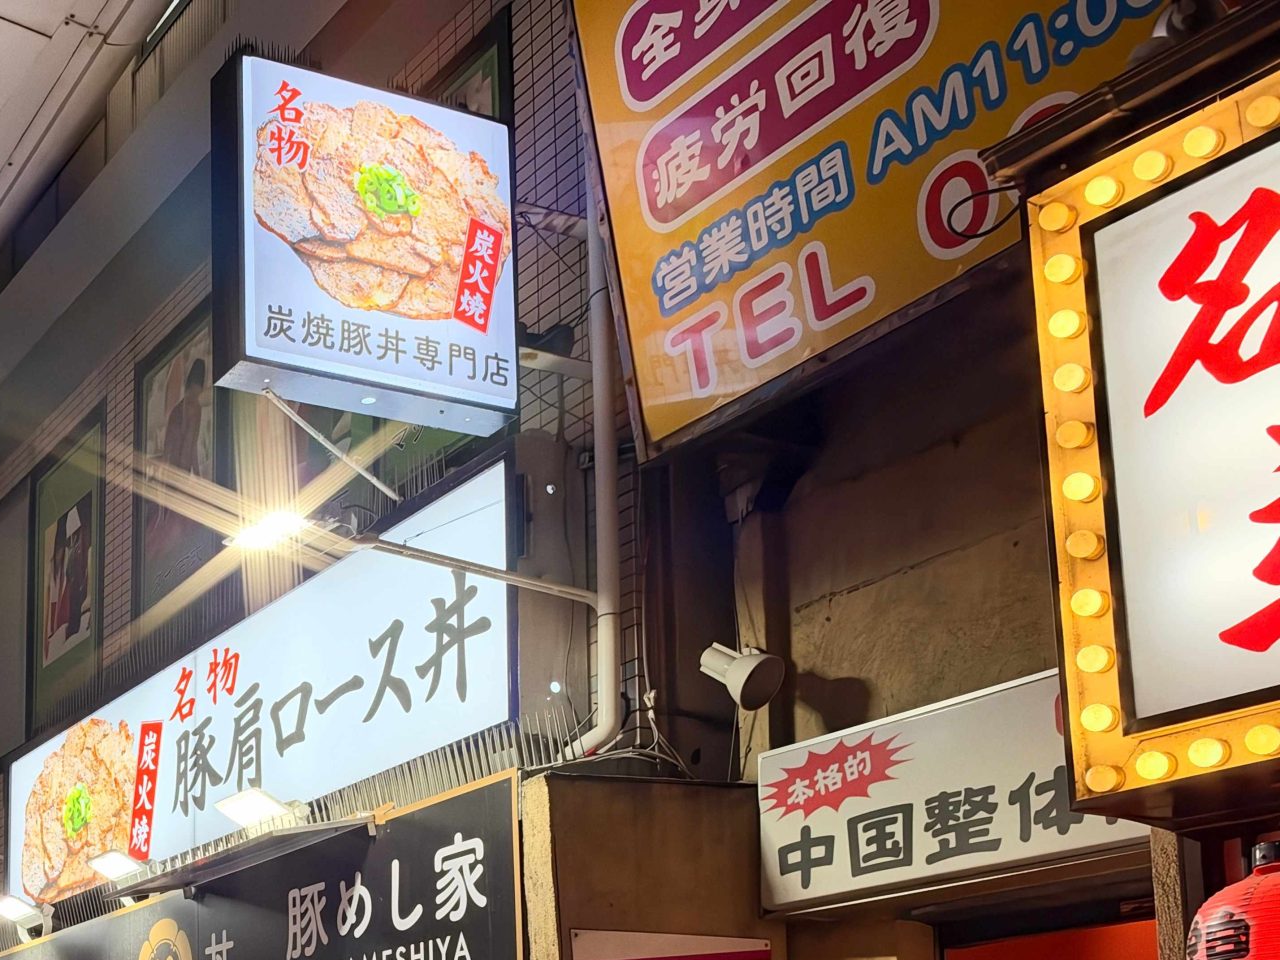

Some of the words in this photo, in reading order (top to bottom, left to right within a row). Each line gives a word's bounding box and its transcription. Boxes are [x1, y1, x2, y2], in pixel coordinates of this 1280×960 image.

[266, 80, 310, 170] 名物
[652, 0, 917, 208] 疲労回復
[656, 148, 849, 310] 営業時間
[872, 0, 1153, 176] AM11:0
[457, 228, 495, 325] 炭火焼
[667, 246, 872, 394] TEL
[264, 305, 509, 388] 炭焼豚丼専門店
[169, 647, 241, 724] 名物
[171, 569, 492, 818] 豚肩ロース丼
[129, 730, 158, 852] 炭火焼
[777, 764, 1118, 890] 中国整体
[786, 749, 873, 806] 本格的
